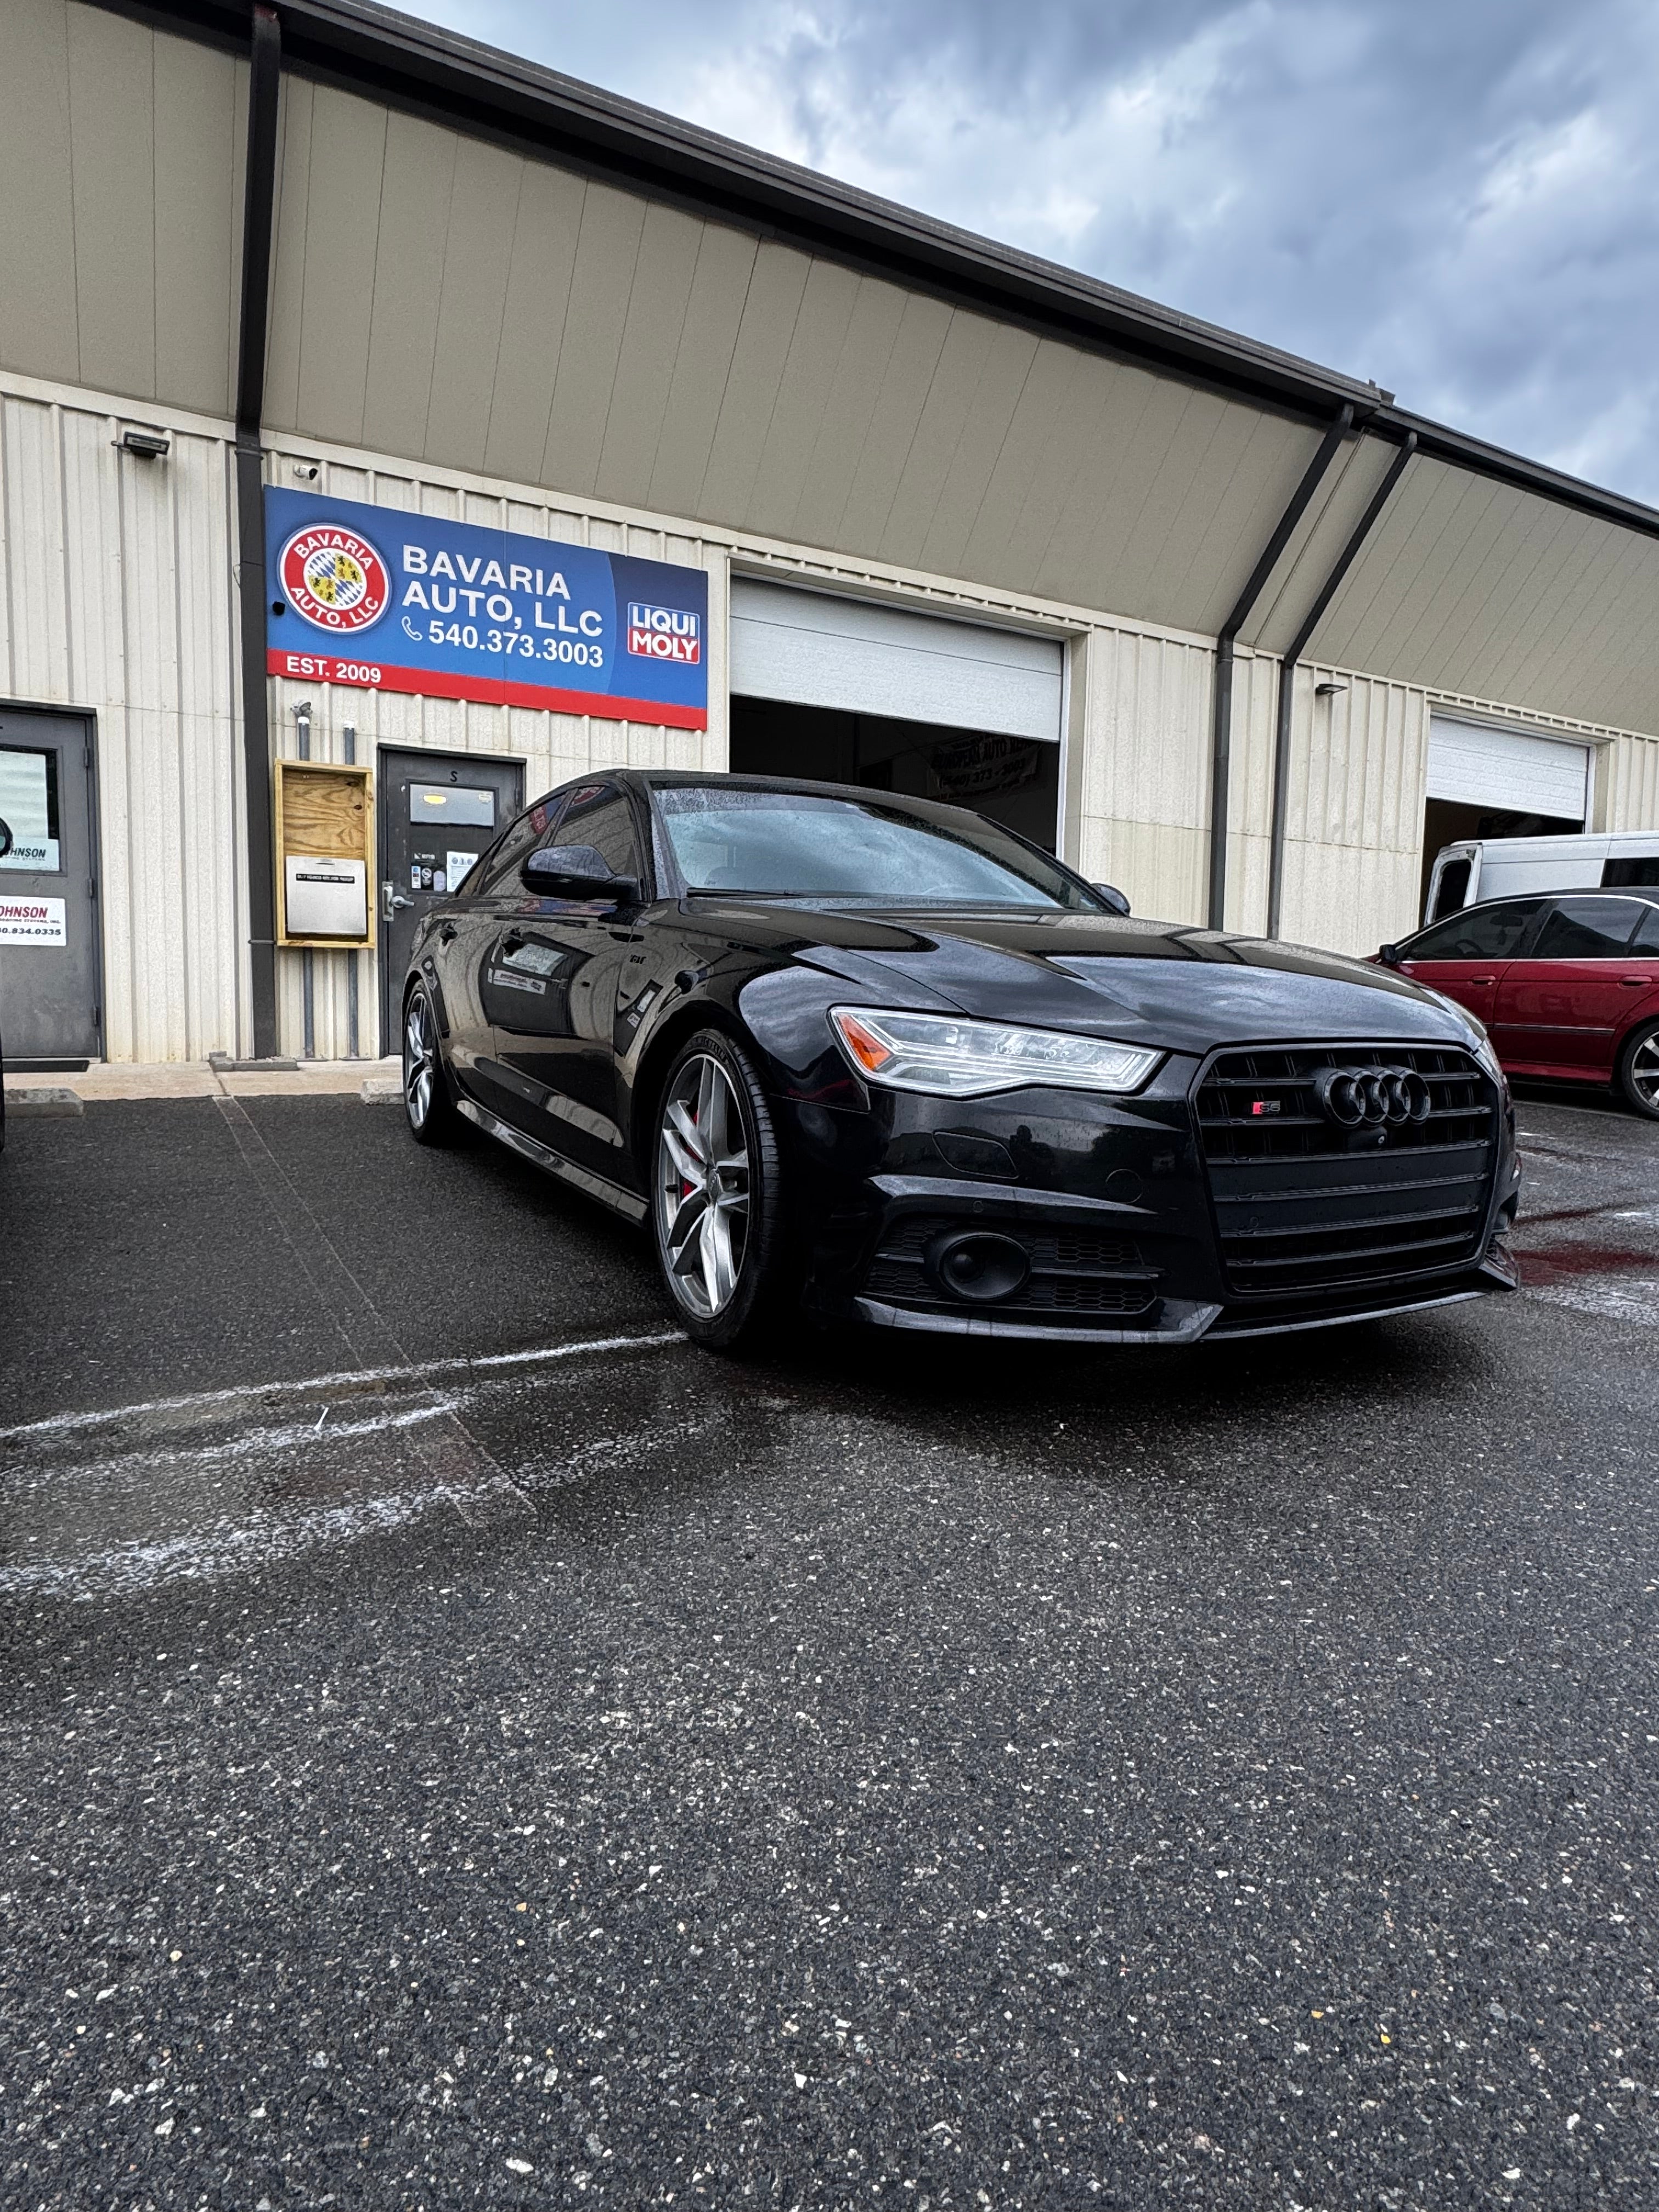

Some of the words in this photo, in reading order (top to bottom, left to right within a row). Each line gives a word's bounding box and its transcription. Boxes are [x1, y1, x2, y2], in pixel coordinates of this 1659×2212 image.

[294, 533, 373, 571] BAVARIA
[403, 544, 571, 601] BAVARIA
[290, 587, 347, 629] AUTO,
[349, 596, 379, 624] LLC
[402, 580, 522, 630] AUTO,
[534, 601, 603, 637] LLC
[633, 606, 696, 637] LIQUI
[428, 620, 603, 668] 540.373.3003
[632, 630, 698, 661] MOLY
[286, 656, 330, 677] EST.
[336, 663, 382, 683] 2009
[10, 847, 46, 858] HNSON
[0, 927, 61, 936] 0.834.0335
